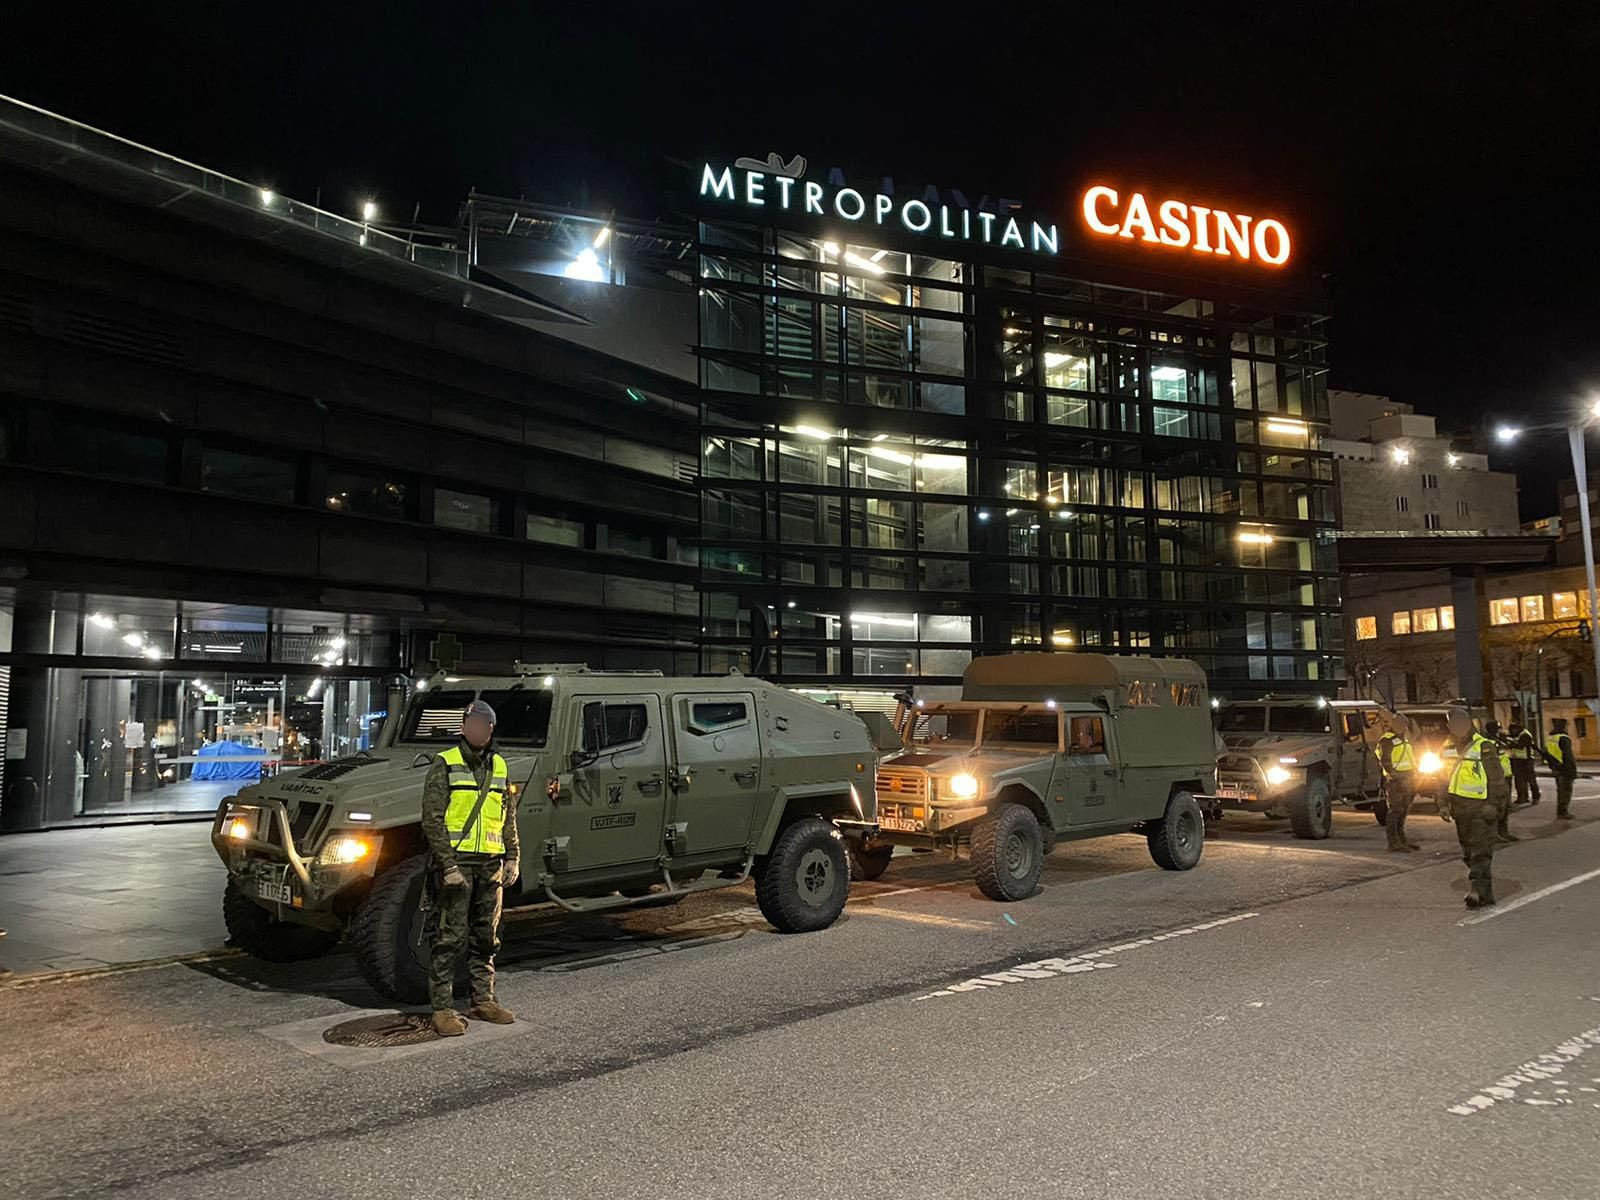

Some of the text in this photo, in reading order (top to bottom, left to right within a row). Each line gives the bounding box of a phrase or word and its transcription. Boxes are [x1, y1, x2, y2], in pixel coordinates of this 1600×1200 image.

[700, 163, 1060, 255] METROPOLITAN
[1082, 185, 1292, 266] CASINO
[280, 783, 324, 795] VAMTAC
